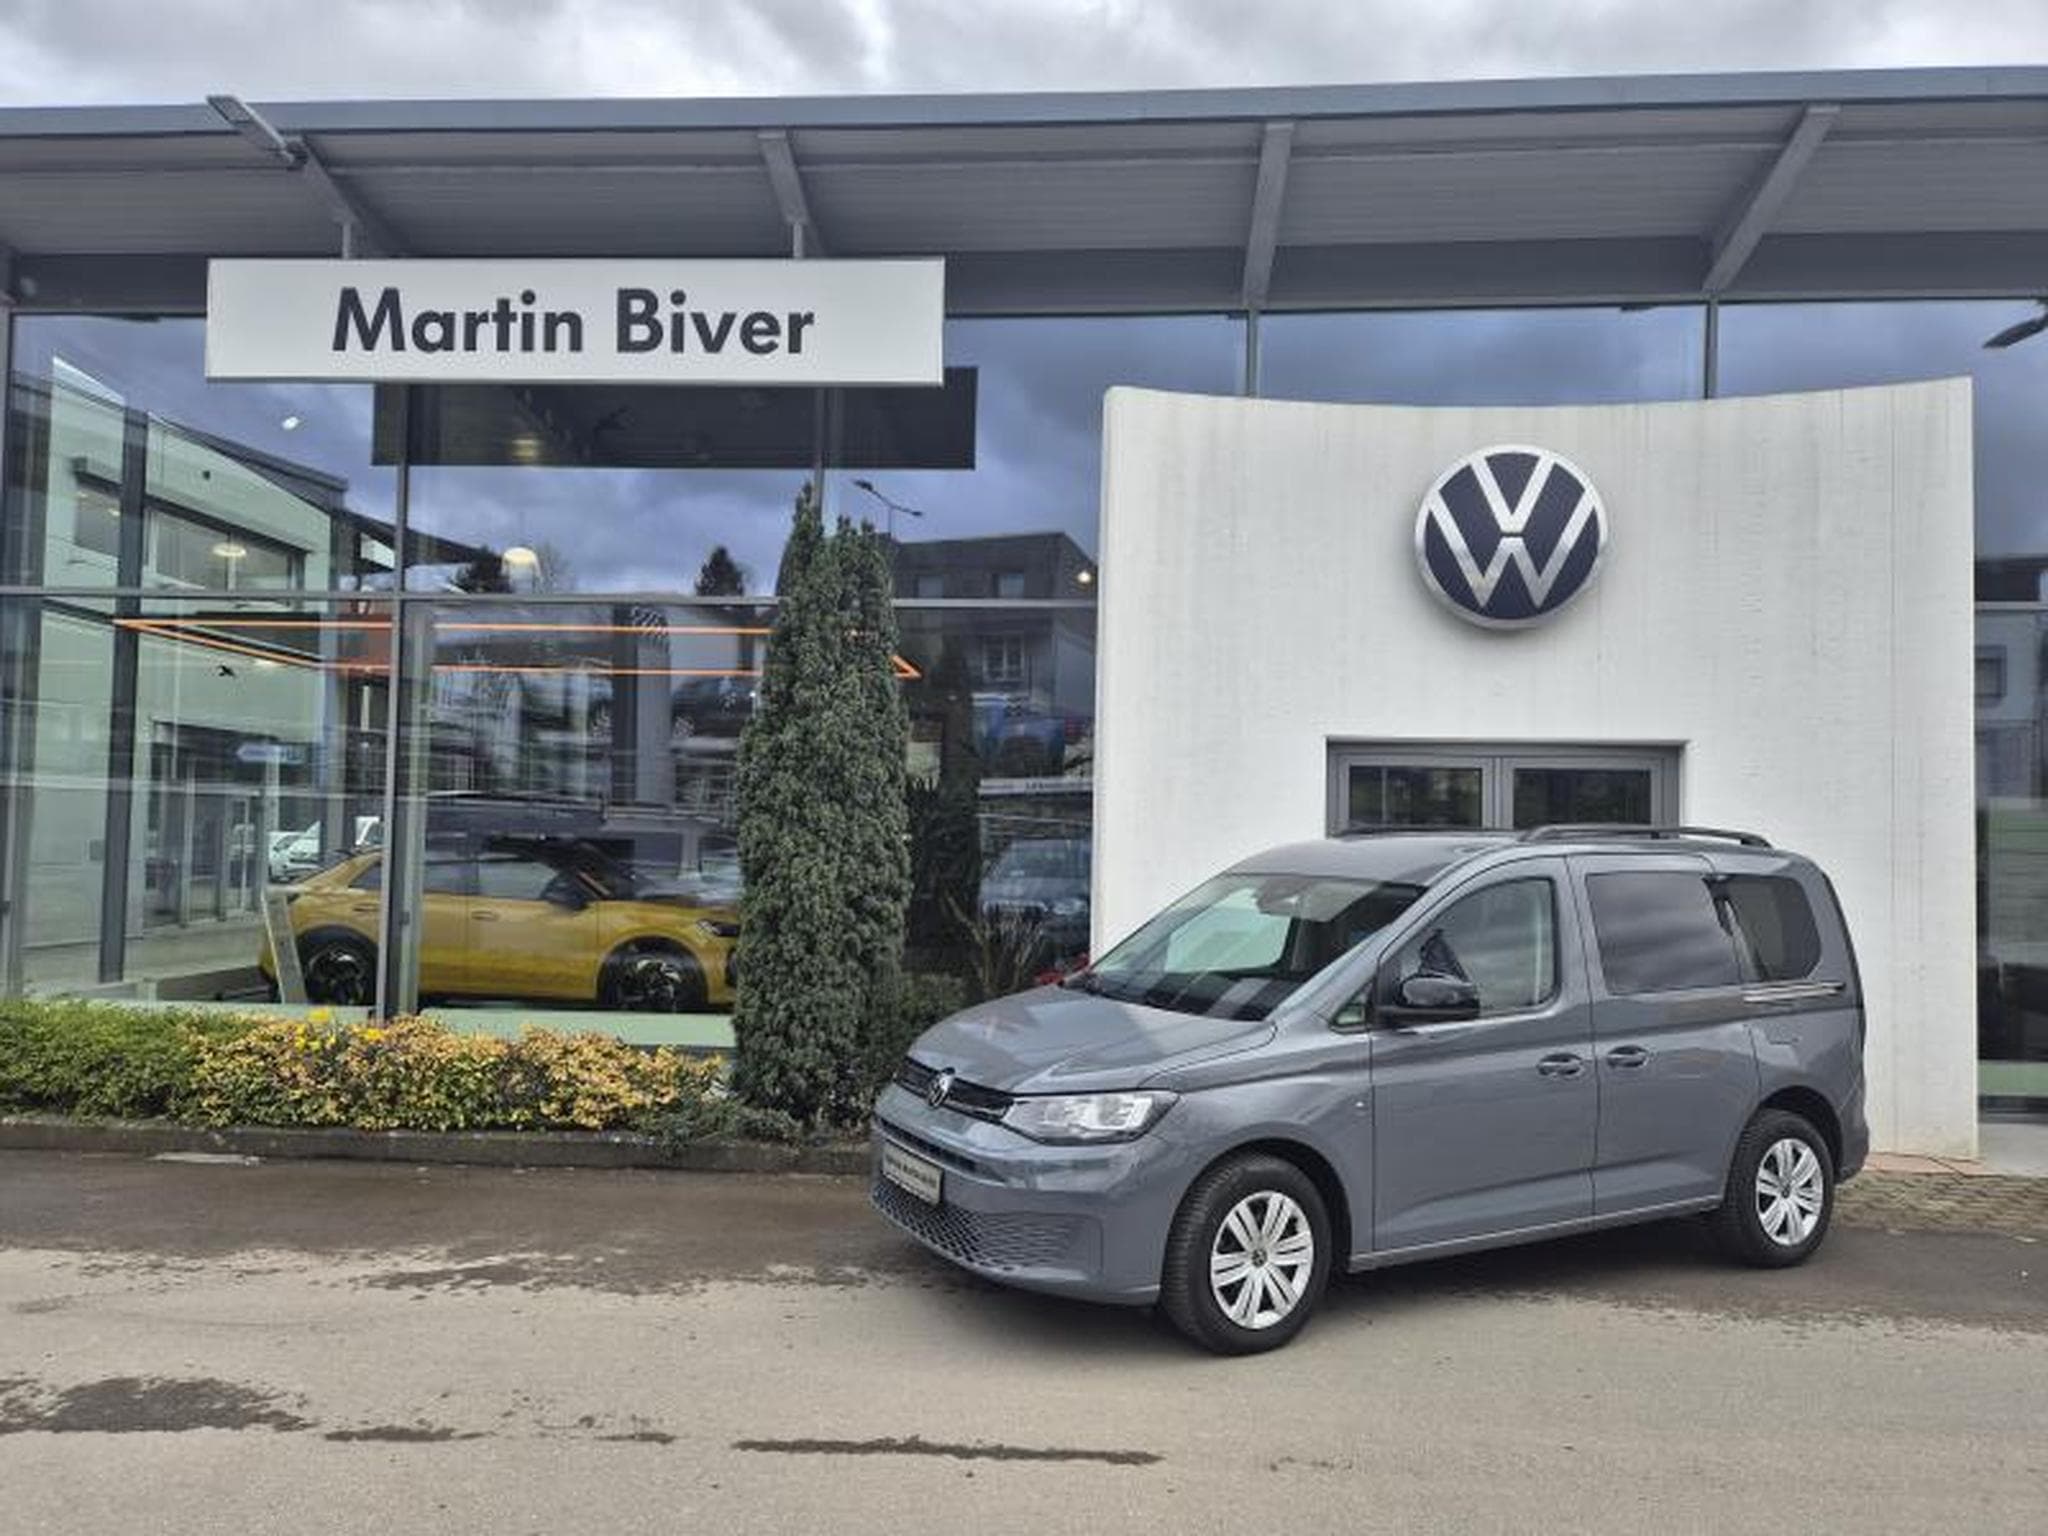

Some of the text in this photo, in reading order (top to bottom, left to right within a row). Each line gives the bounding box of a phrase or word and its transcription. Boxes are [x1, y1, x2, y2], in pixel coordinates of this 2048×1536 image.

[332, 286, 815, 355] Martin Biver
[1421, 450, 1602, 612] VW
